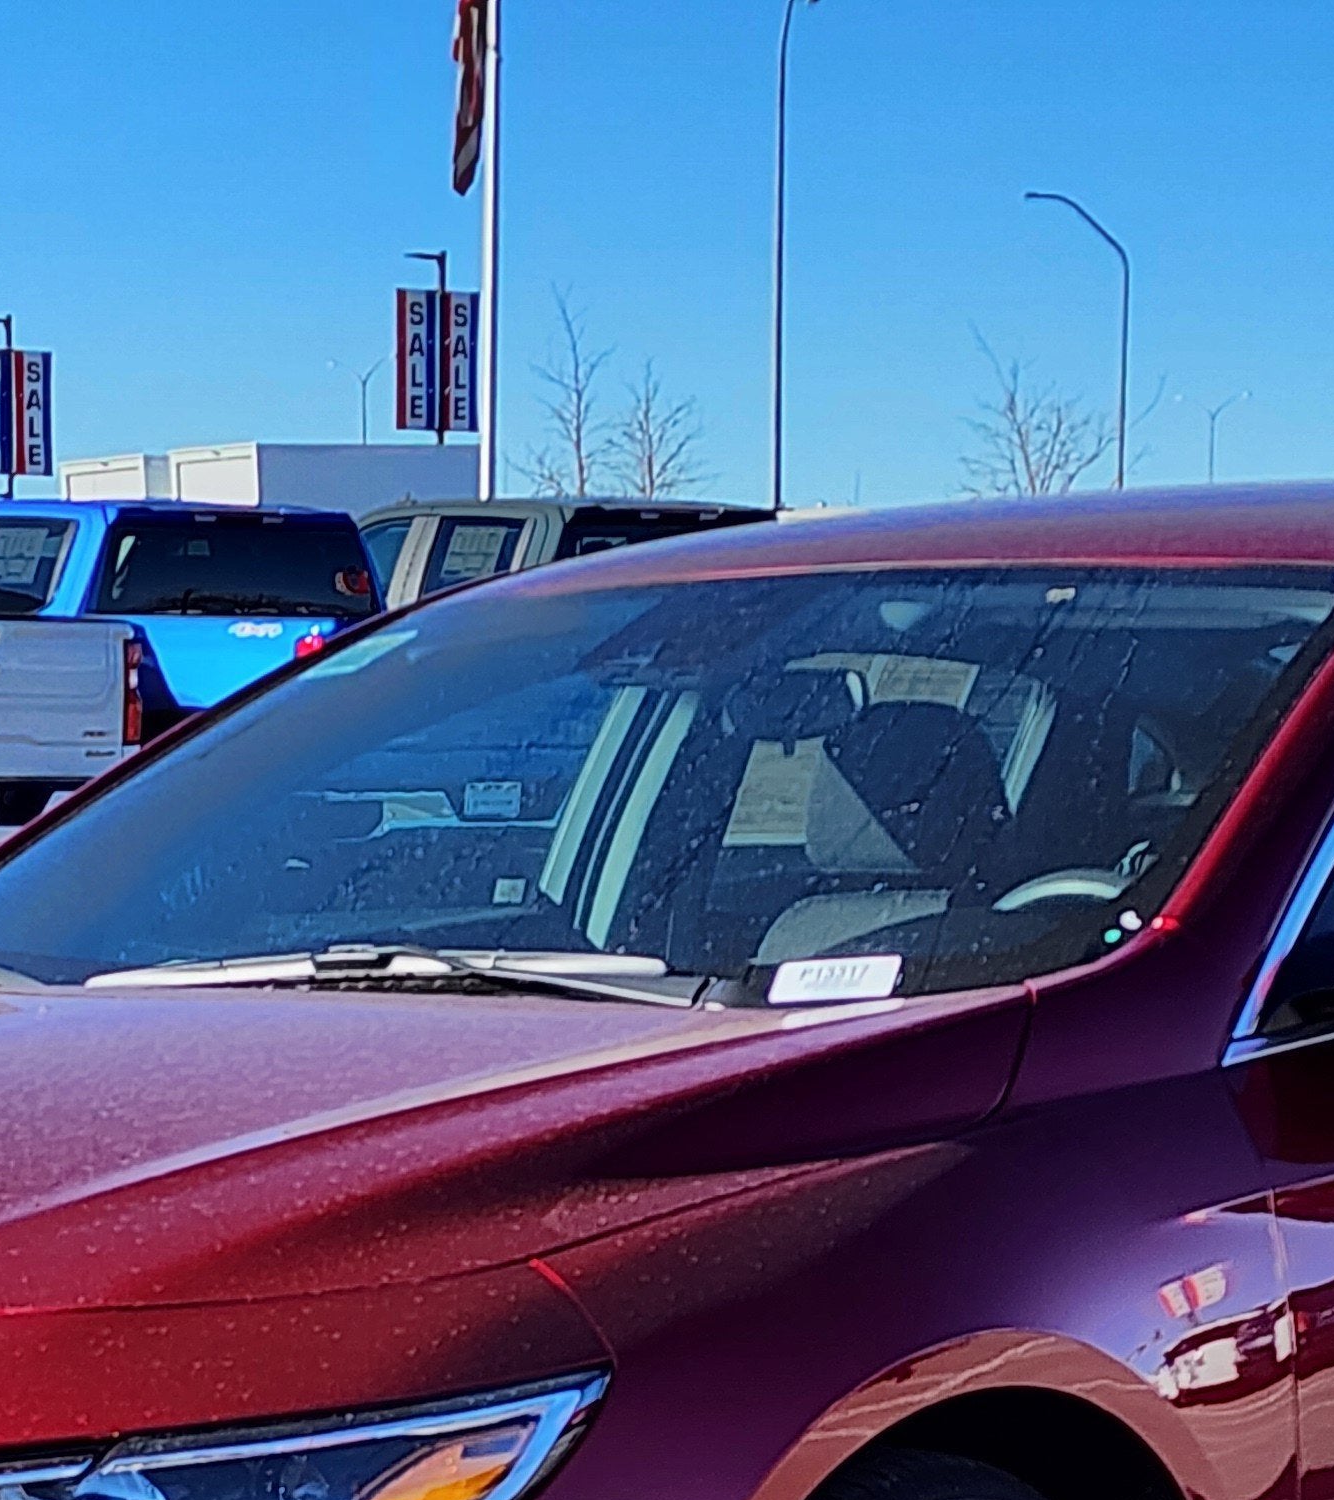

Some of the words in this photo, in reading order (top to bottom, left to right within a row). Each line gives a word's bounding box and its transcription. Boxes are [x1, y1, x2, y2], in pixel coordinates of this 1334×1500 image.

[26, 361, 42, 466] SALE
[408, 301, 425, 419] SALE
[452, 303, 468, 421] SALE
